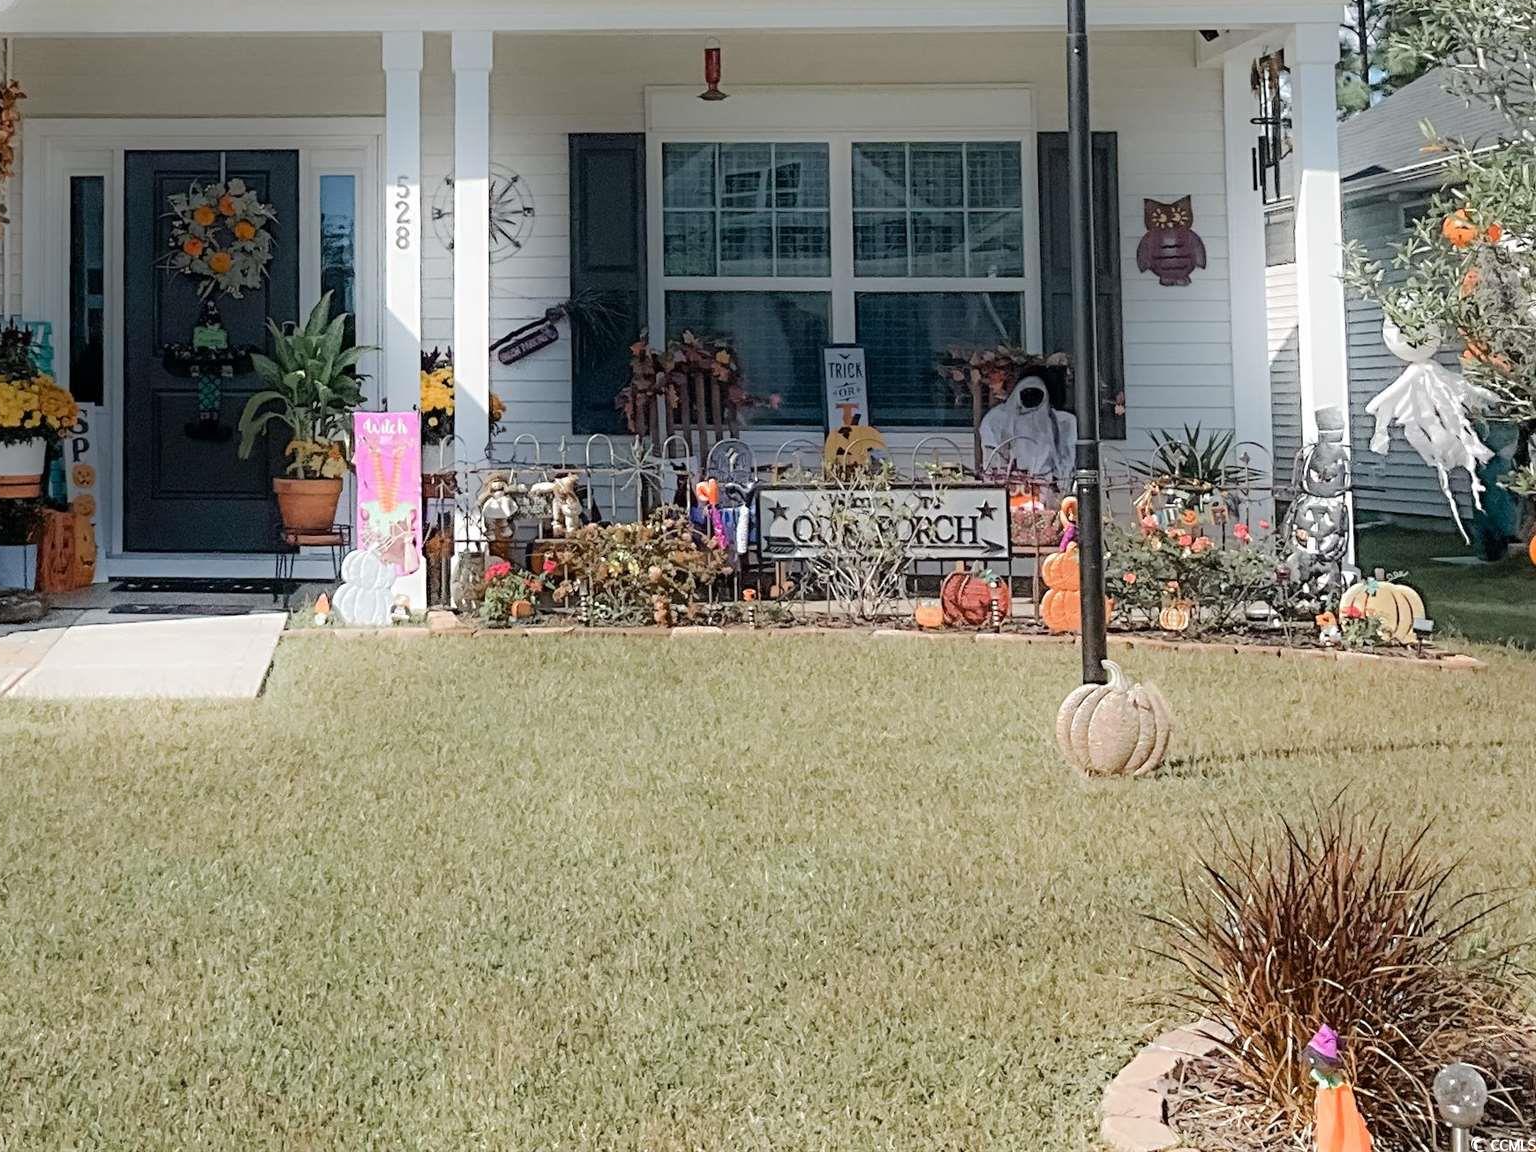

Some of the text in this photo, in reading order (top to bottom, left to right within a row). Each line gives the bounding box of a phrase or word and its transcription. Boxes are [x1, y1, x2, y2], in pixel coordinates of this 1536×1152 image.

[395, 174, 411, 250] 528
[828, 362, 863, 378] TRICK
[838, 388, 855, 398] OR
